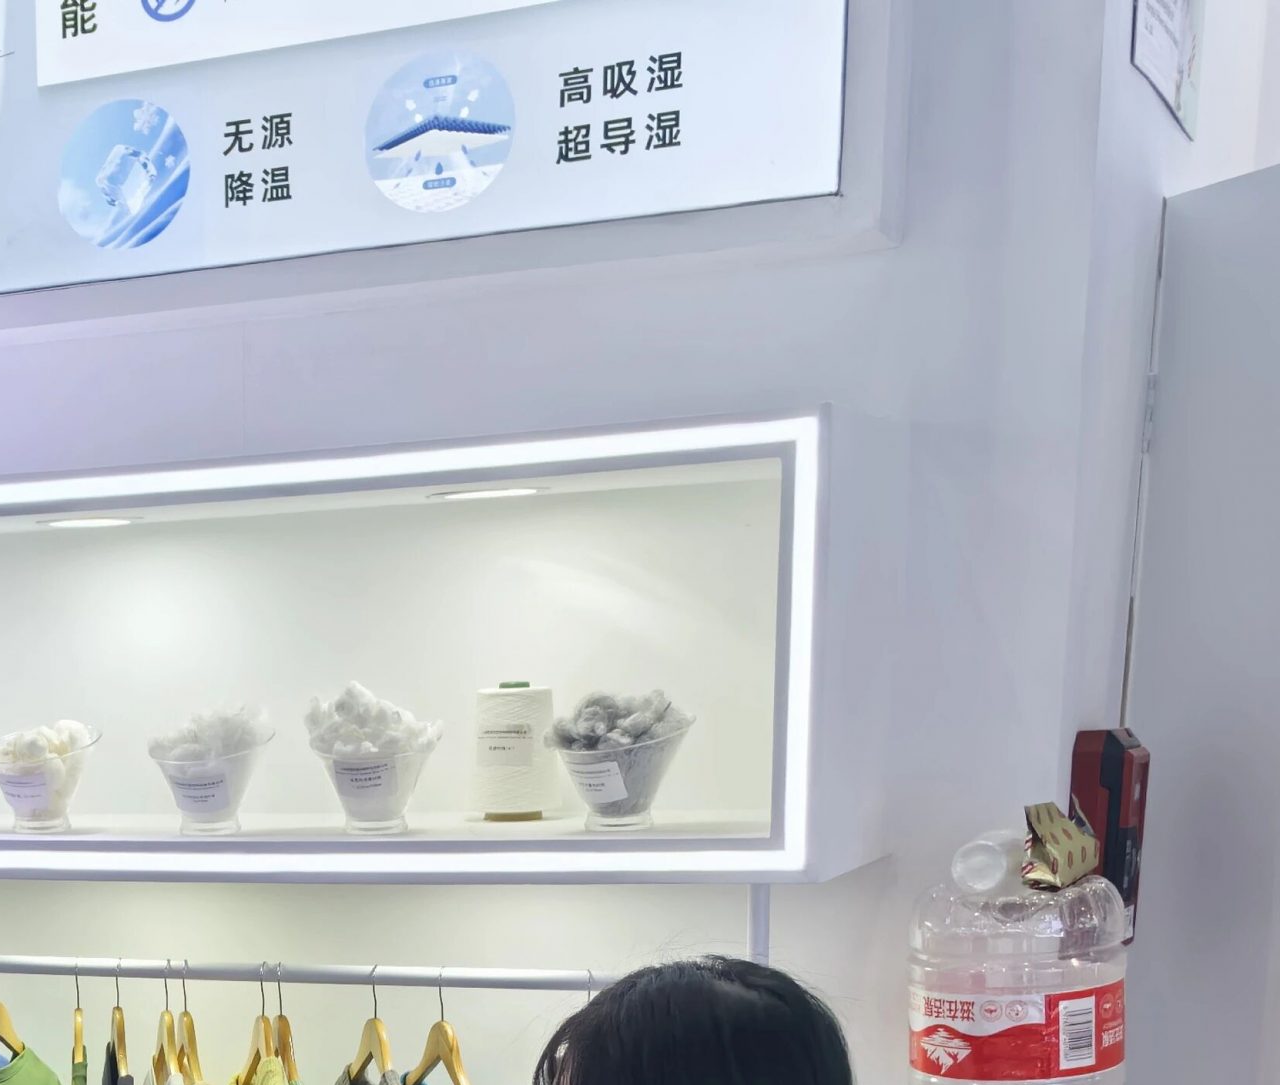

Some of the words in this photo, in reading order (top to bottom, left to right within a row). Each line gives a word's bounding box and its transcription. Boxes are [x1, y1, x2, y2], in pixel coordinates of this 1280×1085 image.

[558, 51, 683, 108] 高吸湿
[223, 112, 293, 157] 无源
[556, 110, 682, 165] 超导湿
[223, 166, 293, 208] 降温
[923, 995, 975, 1022] 滋在活泉
